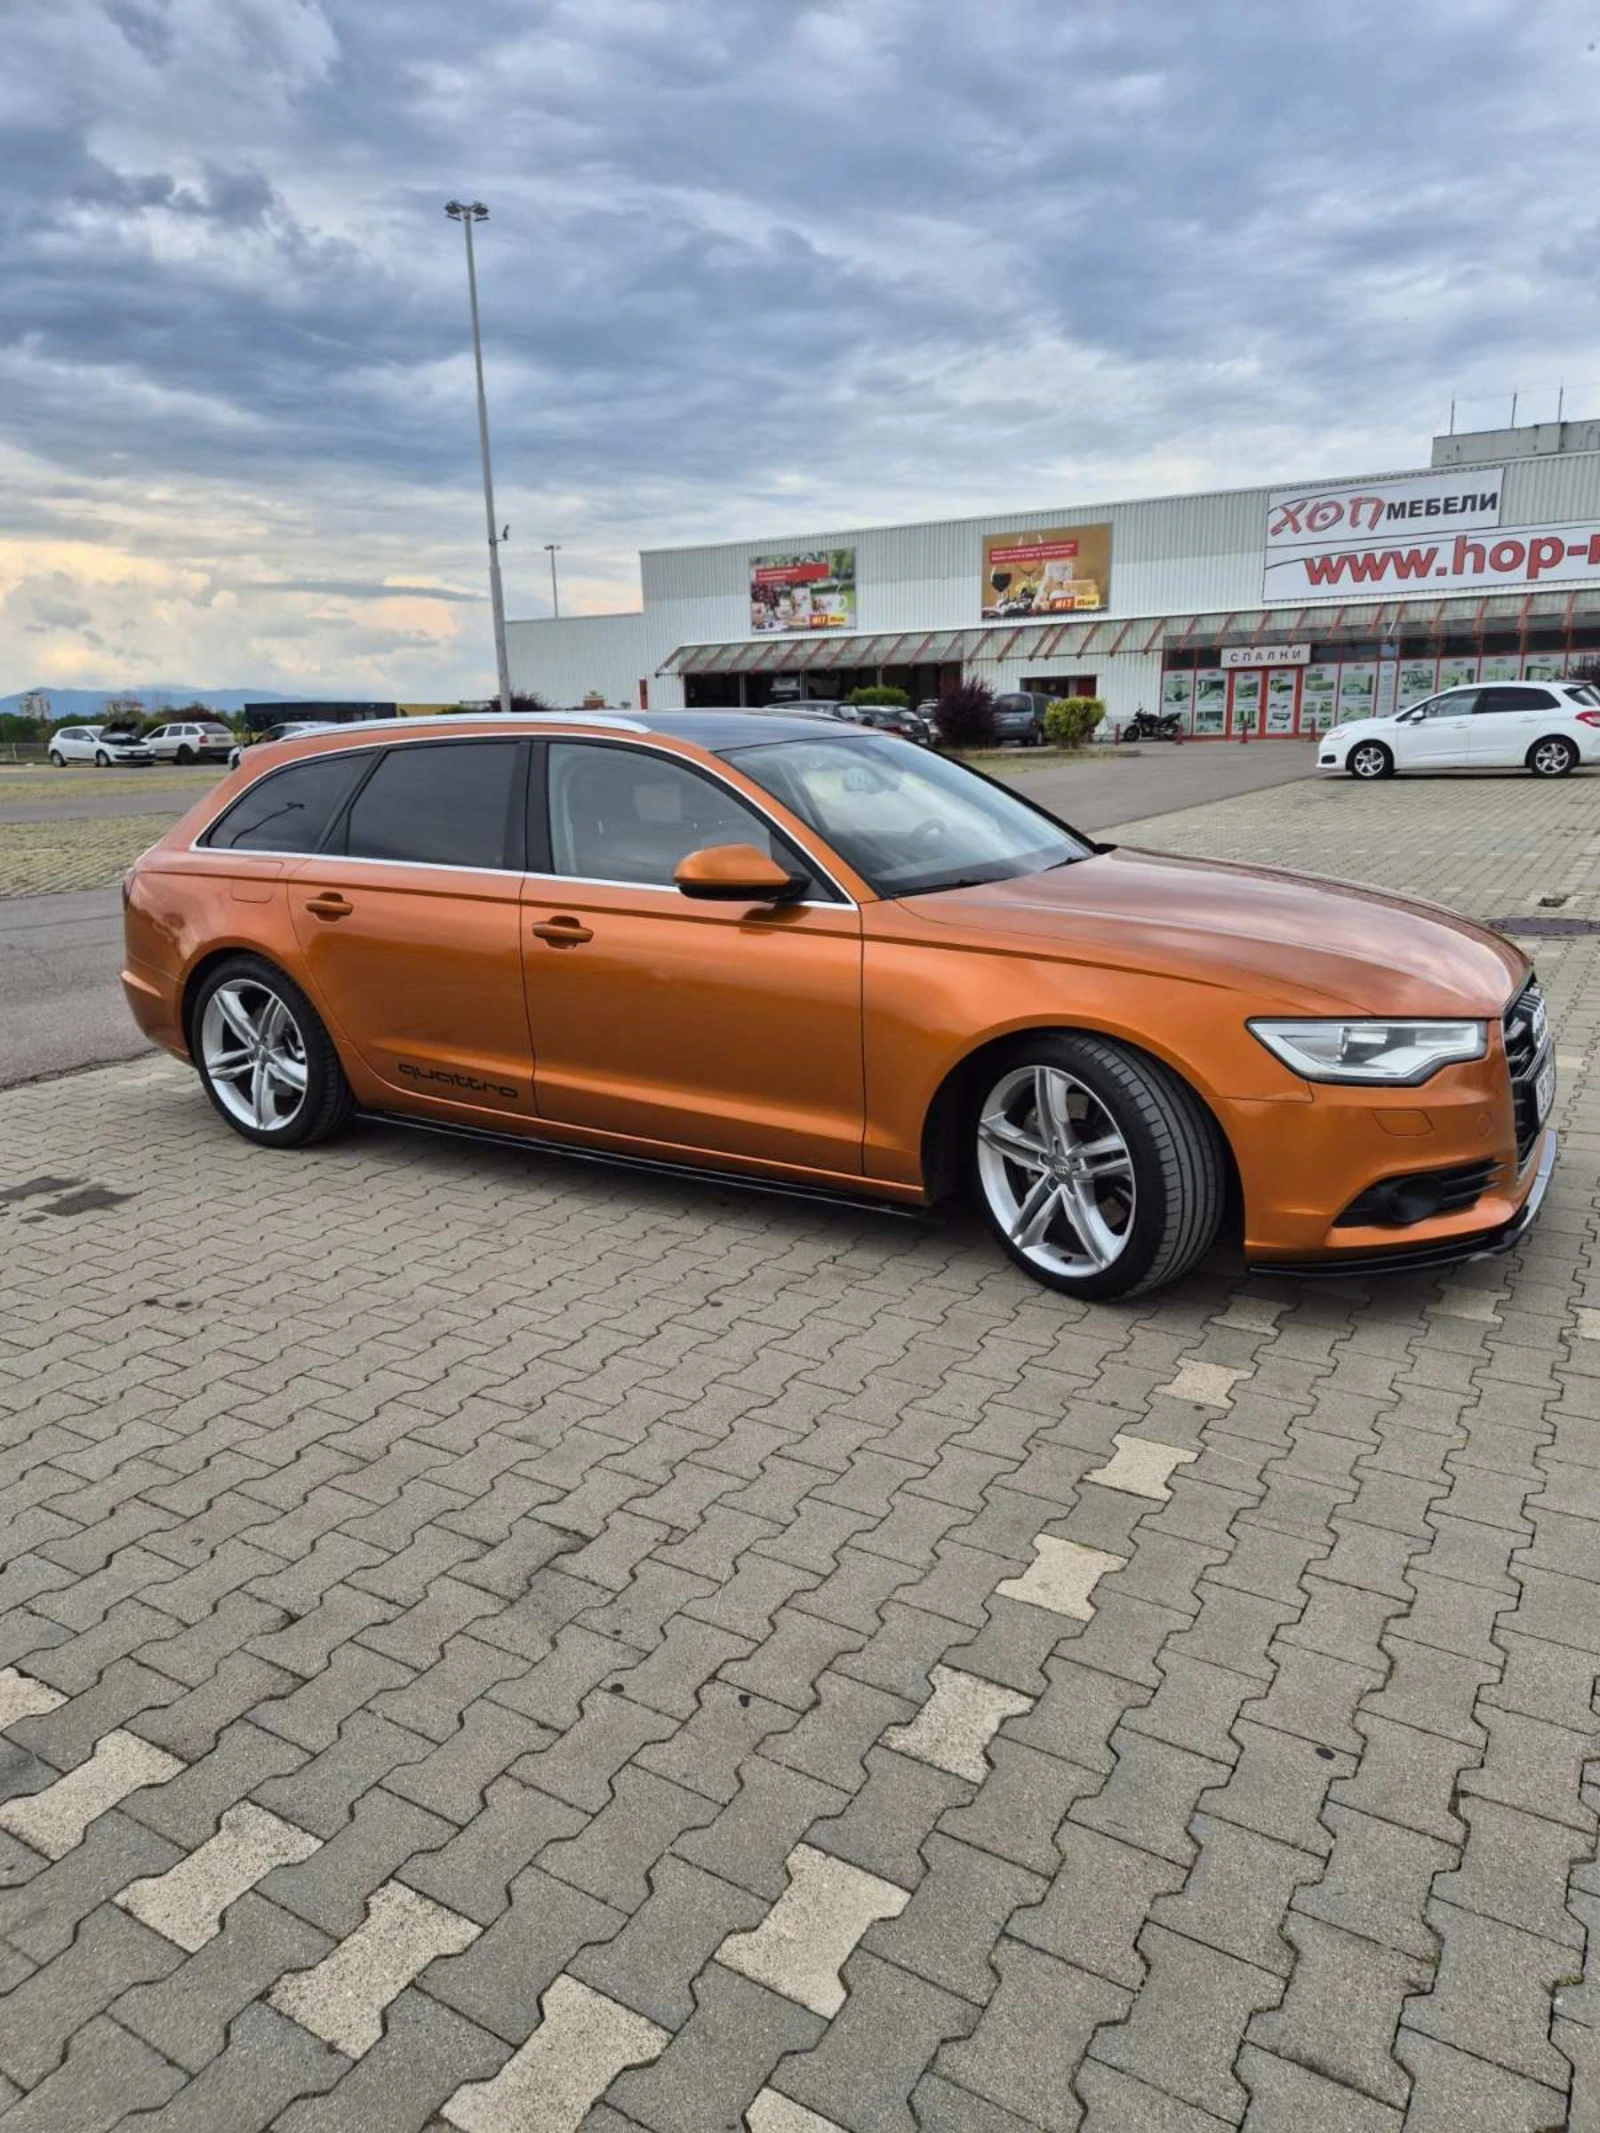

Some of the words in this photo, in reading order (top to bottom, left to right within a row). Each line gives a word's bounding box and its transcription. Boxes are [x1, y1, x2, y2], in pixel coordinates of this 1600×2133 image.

[1270, 497, 1385, 536] ХОП
[1386, 492, 1498, 520] МЕБЕЛИ
[1304, 534, 1600, 586] www.hop-
[1230, 649, 1302, 663] СПАЛНИ
[398, 1063, 518, 1098] quattro
